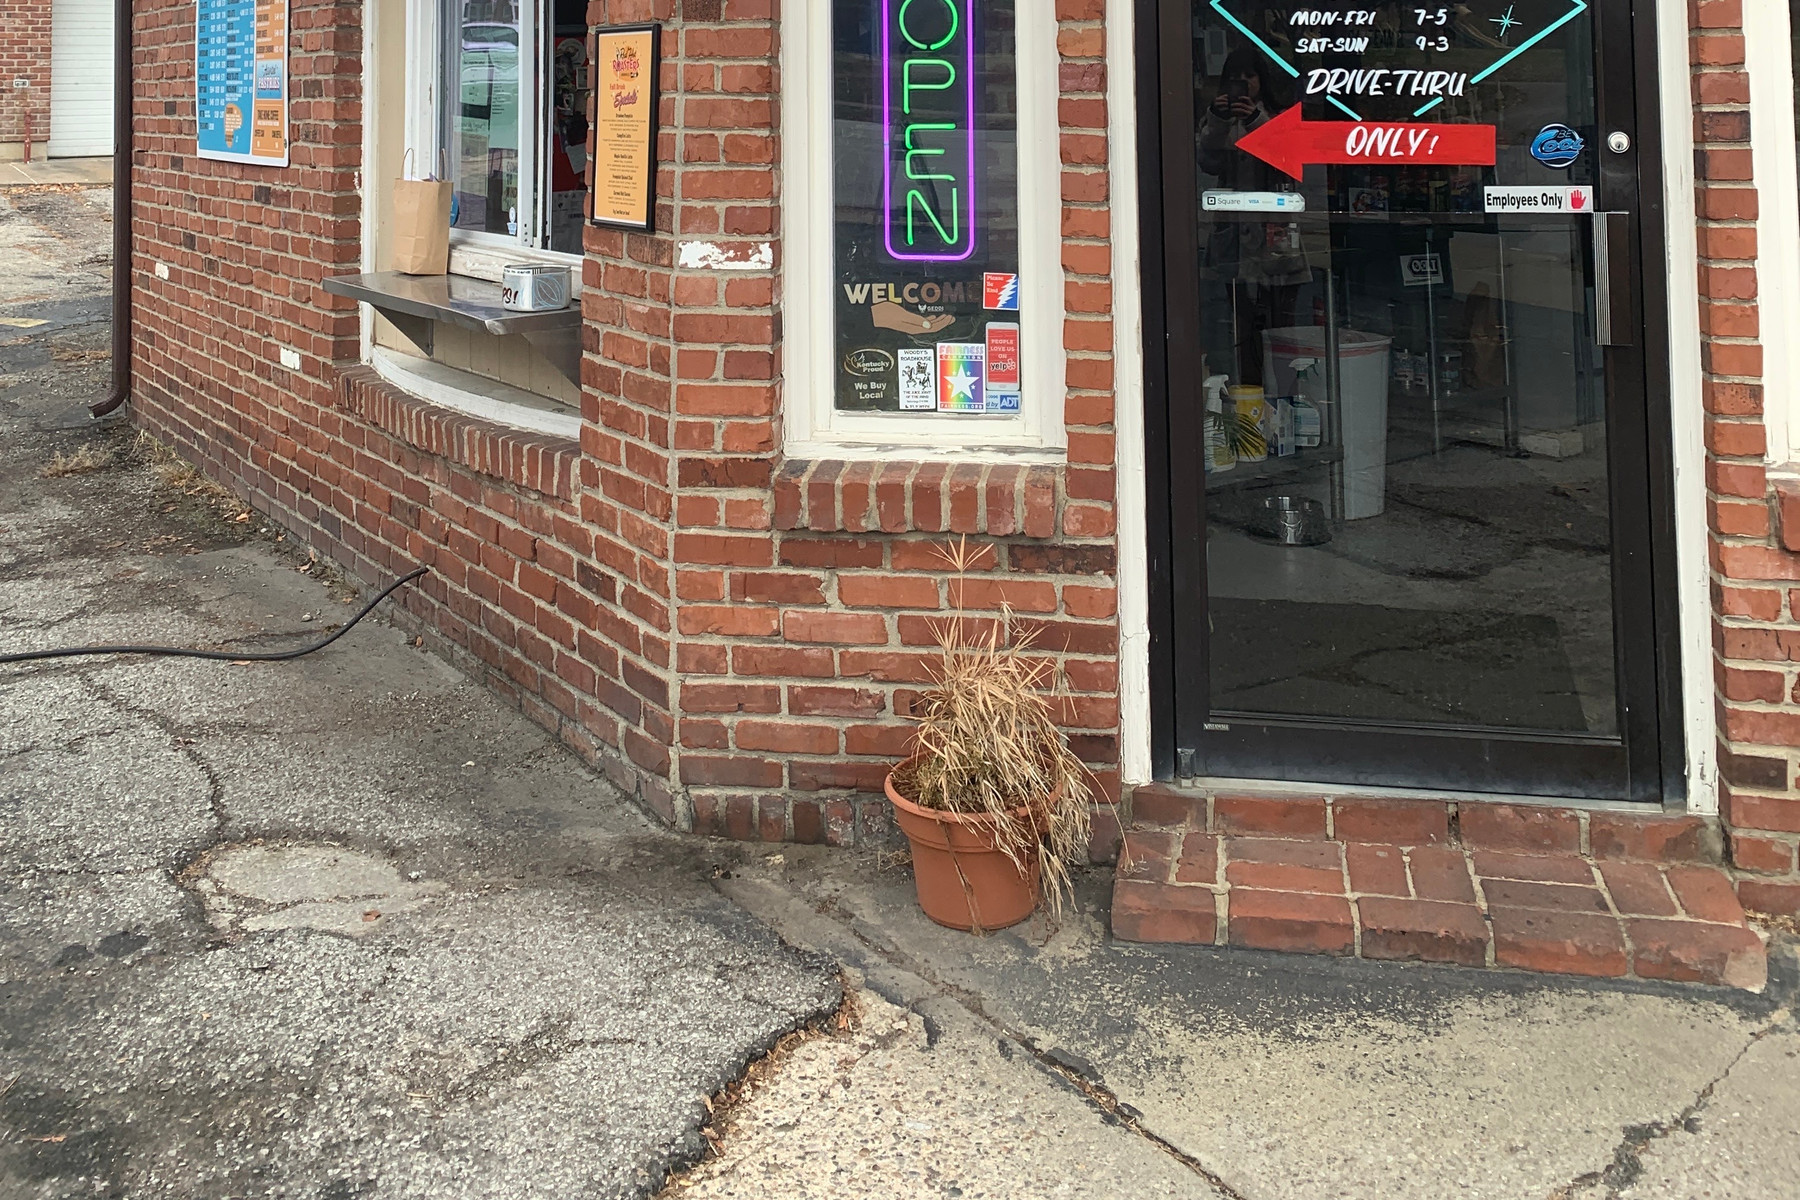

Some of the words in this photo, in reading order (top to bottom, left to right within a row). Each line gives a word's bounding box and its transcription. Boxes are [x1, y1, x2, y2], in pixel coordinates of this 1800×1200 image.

[1290, 11, 1377, 26] MON-FRI
[1414, 8, 1448, 26] 7-5
[1295, 37, 1370, 53] SAT-SUN
[1415, 36, 1449, 52] 9-3
[612, 58, 640, 72] ROASTERS
[1306, 68, 1467, 97] DRIVE-THRU
[1557, 129, 1572, 139] BE
[1346, 126, 1439, 157] ONLY!
[1217, 197, 1241, 205] Square
[1486, 193, 1538, 209] Employees
[1541, 192, 1563, 209] Only
[843, 281, 981, 305] WELCOME
[990, 362, 1008, 371] yelp
[870, 381, 887, 391] Buy
[859, 391, 884, 400] Local
[1000, 396, 1018, 408] ADT
